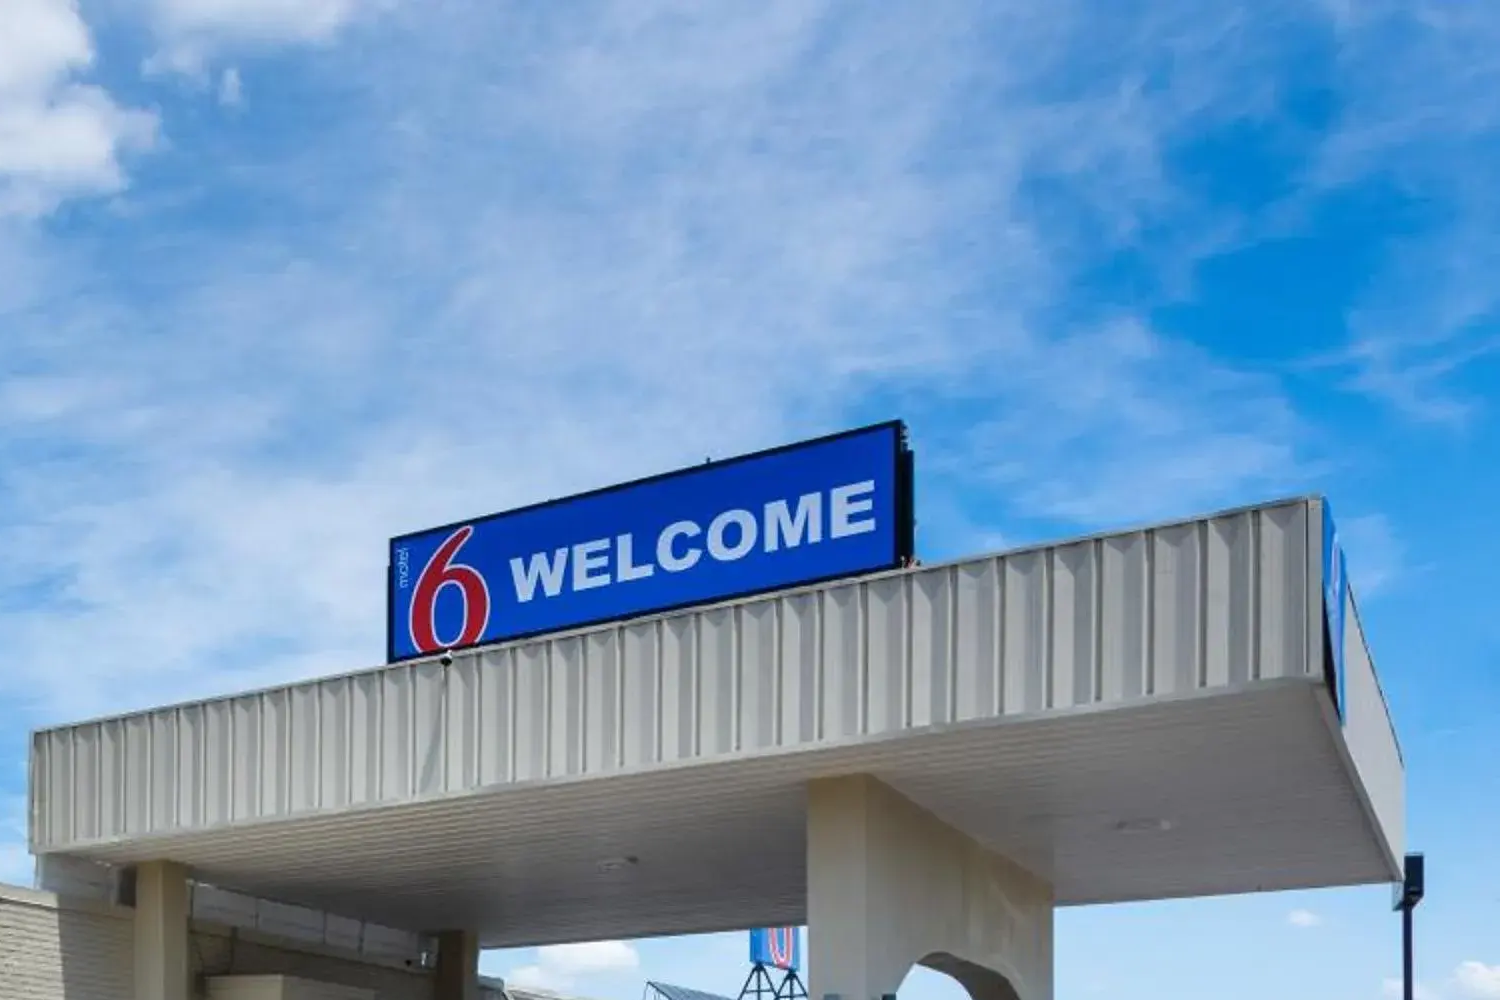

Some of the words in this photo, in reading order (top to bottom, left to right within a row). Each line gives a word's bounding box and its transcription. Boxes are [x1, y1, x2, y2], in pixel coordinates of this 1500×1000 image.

[395, 547, 409, 589] motel
[408, 525, 491, 654] 6
[509, 479, 877, 603] WELCOME
